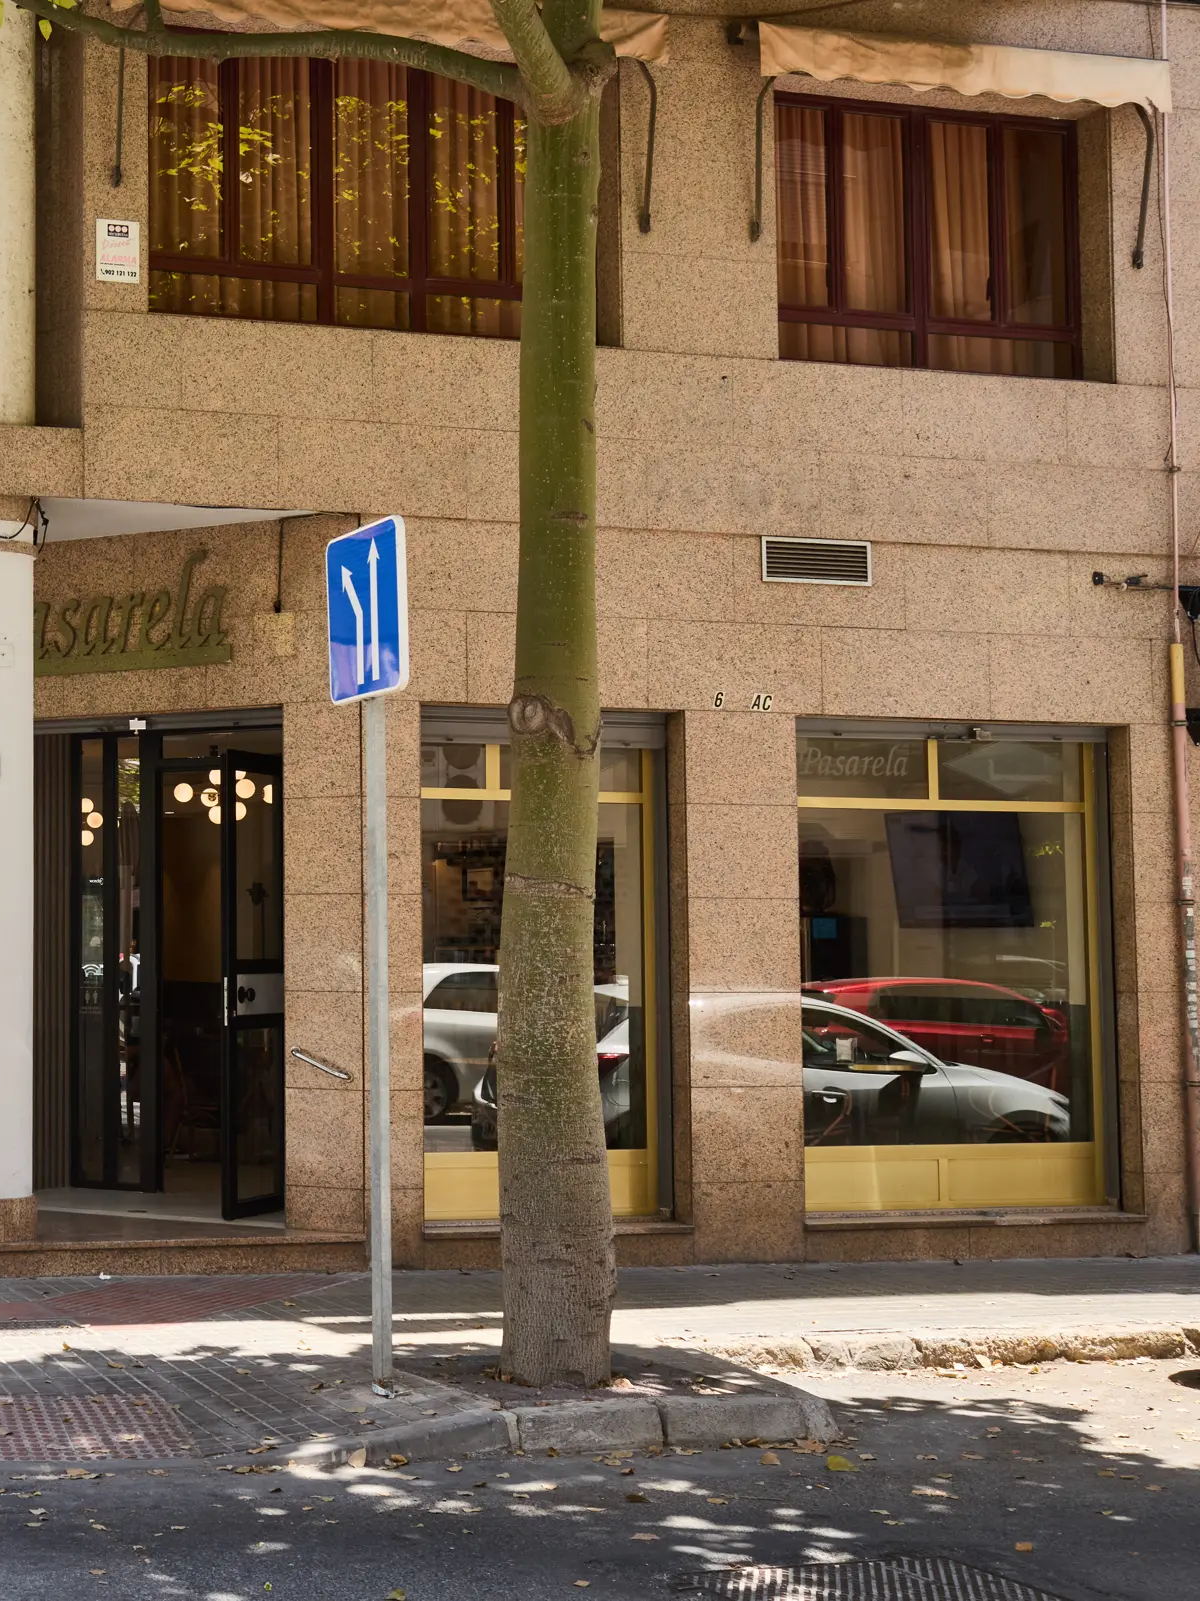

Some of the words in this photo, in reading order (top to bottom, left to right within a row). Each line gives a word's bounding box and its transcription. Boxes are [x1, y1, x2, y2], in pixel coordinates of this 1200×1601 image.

[100, 254, 137, 264] ALARMA
[714, 692, 724, 708] 6
[751, 694, 773, 711] AC
[801, 744, 909, 777] Pasarela
